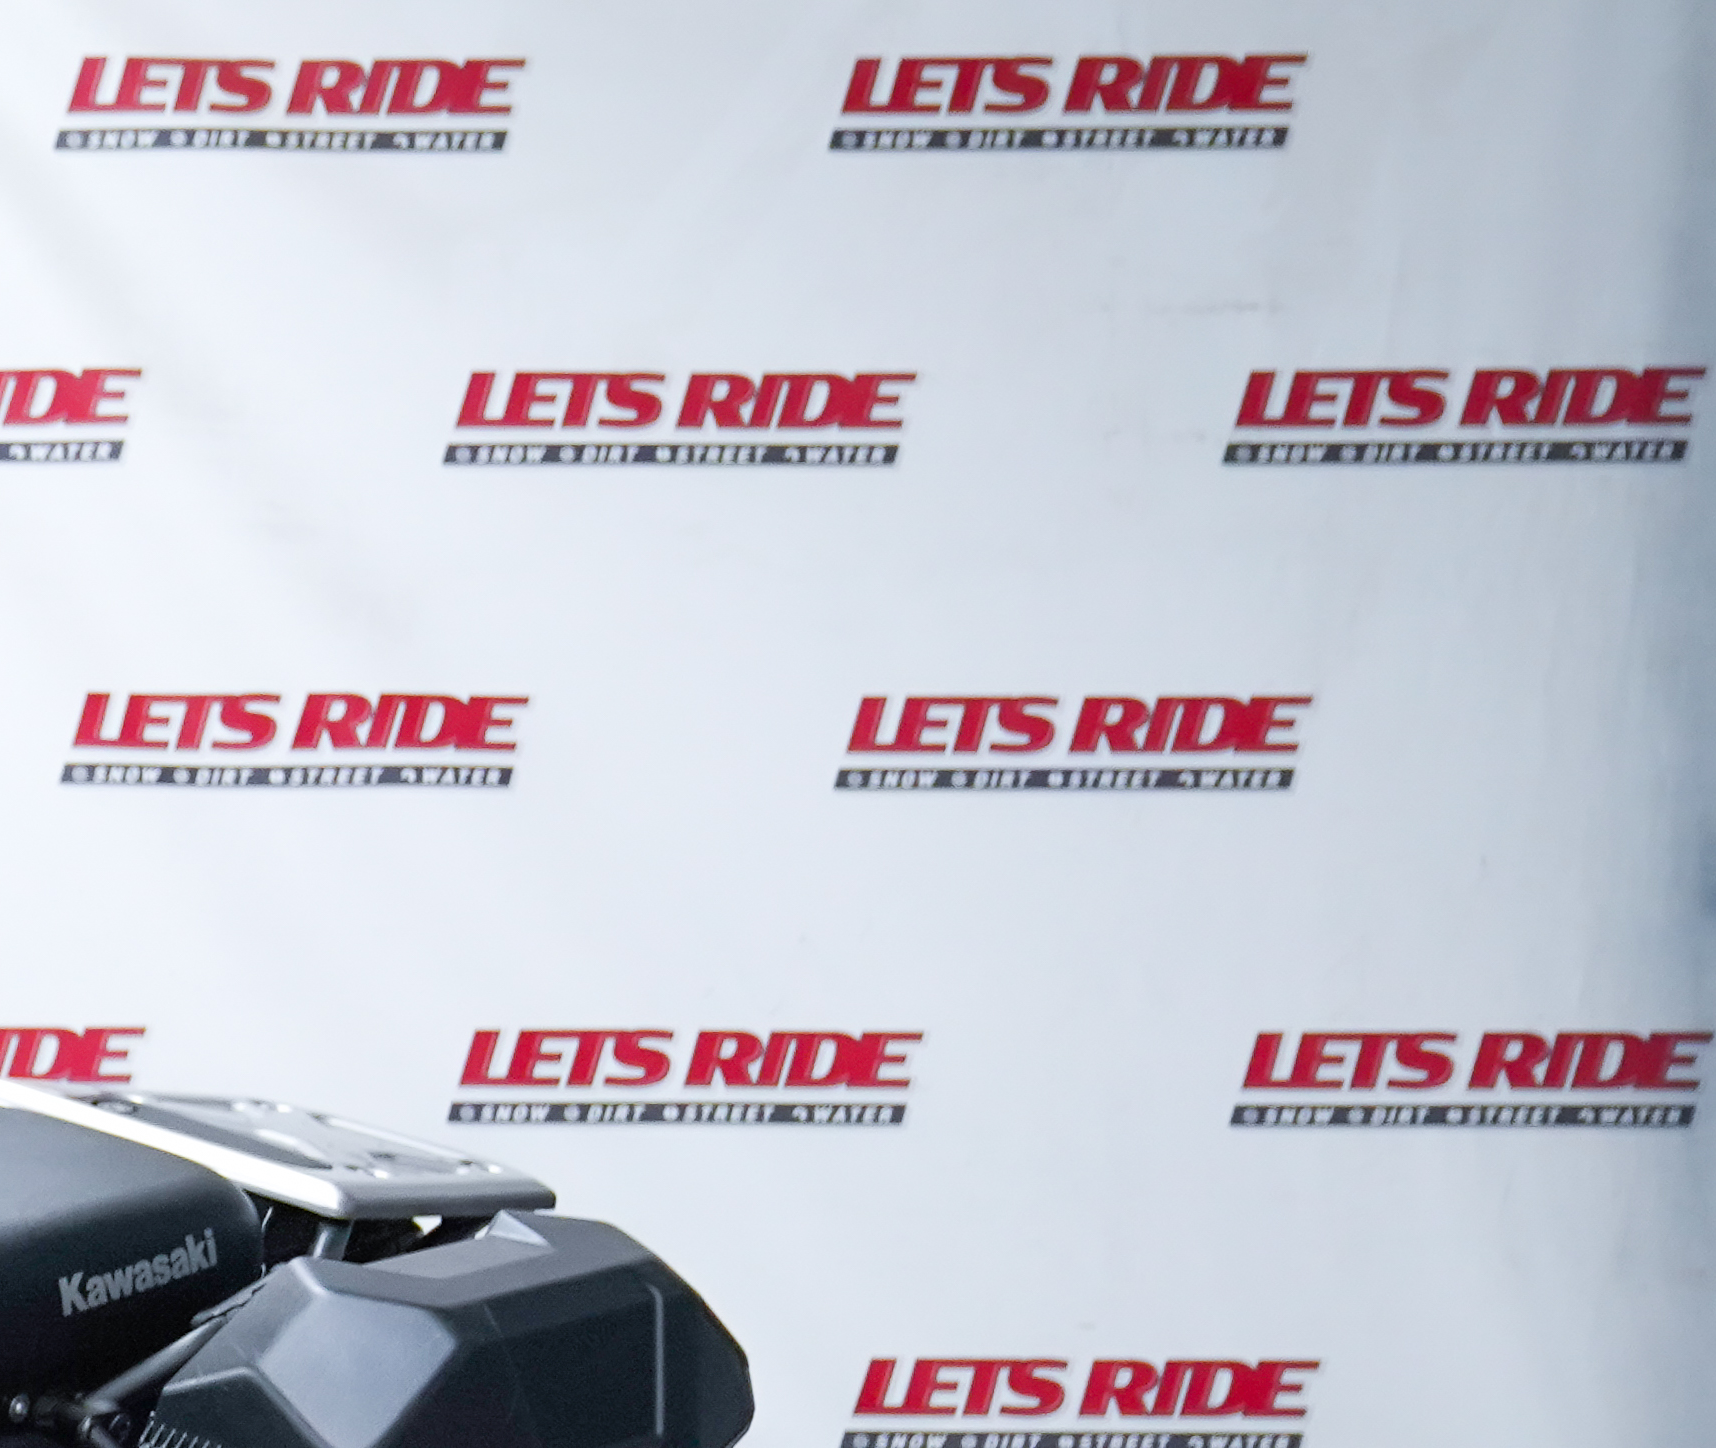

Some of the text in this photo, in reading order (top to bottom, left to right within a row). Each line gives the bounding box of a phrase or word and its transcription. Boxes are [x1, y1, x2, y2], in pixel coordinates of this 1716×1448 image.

[70, 57, 524, 114] LETS RIDE
[843, 55, 1304, 112] LETS RIDE
[458, 372, 916, 427] LETS RIDE
[1238, 369, 1704, 426] LETS RIDE
[74, 693, 528, 750] LETS RIDE
[848, 697, 1311, 752] LETS RIDE
[461, 1030, 922, 1087] LETS RIDE
[1244, 1032, 1715, 1088] LETS RIDE
[58, 1227, 218, 1317] Kawasaki
[855, 1359, 1318, 1416] LETS RIDE
